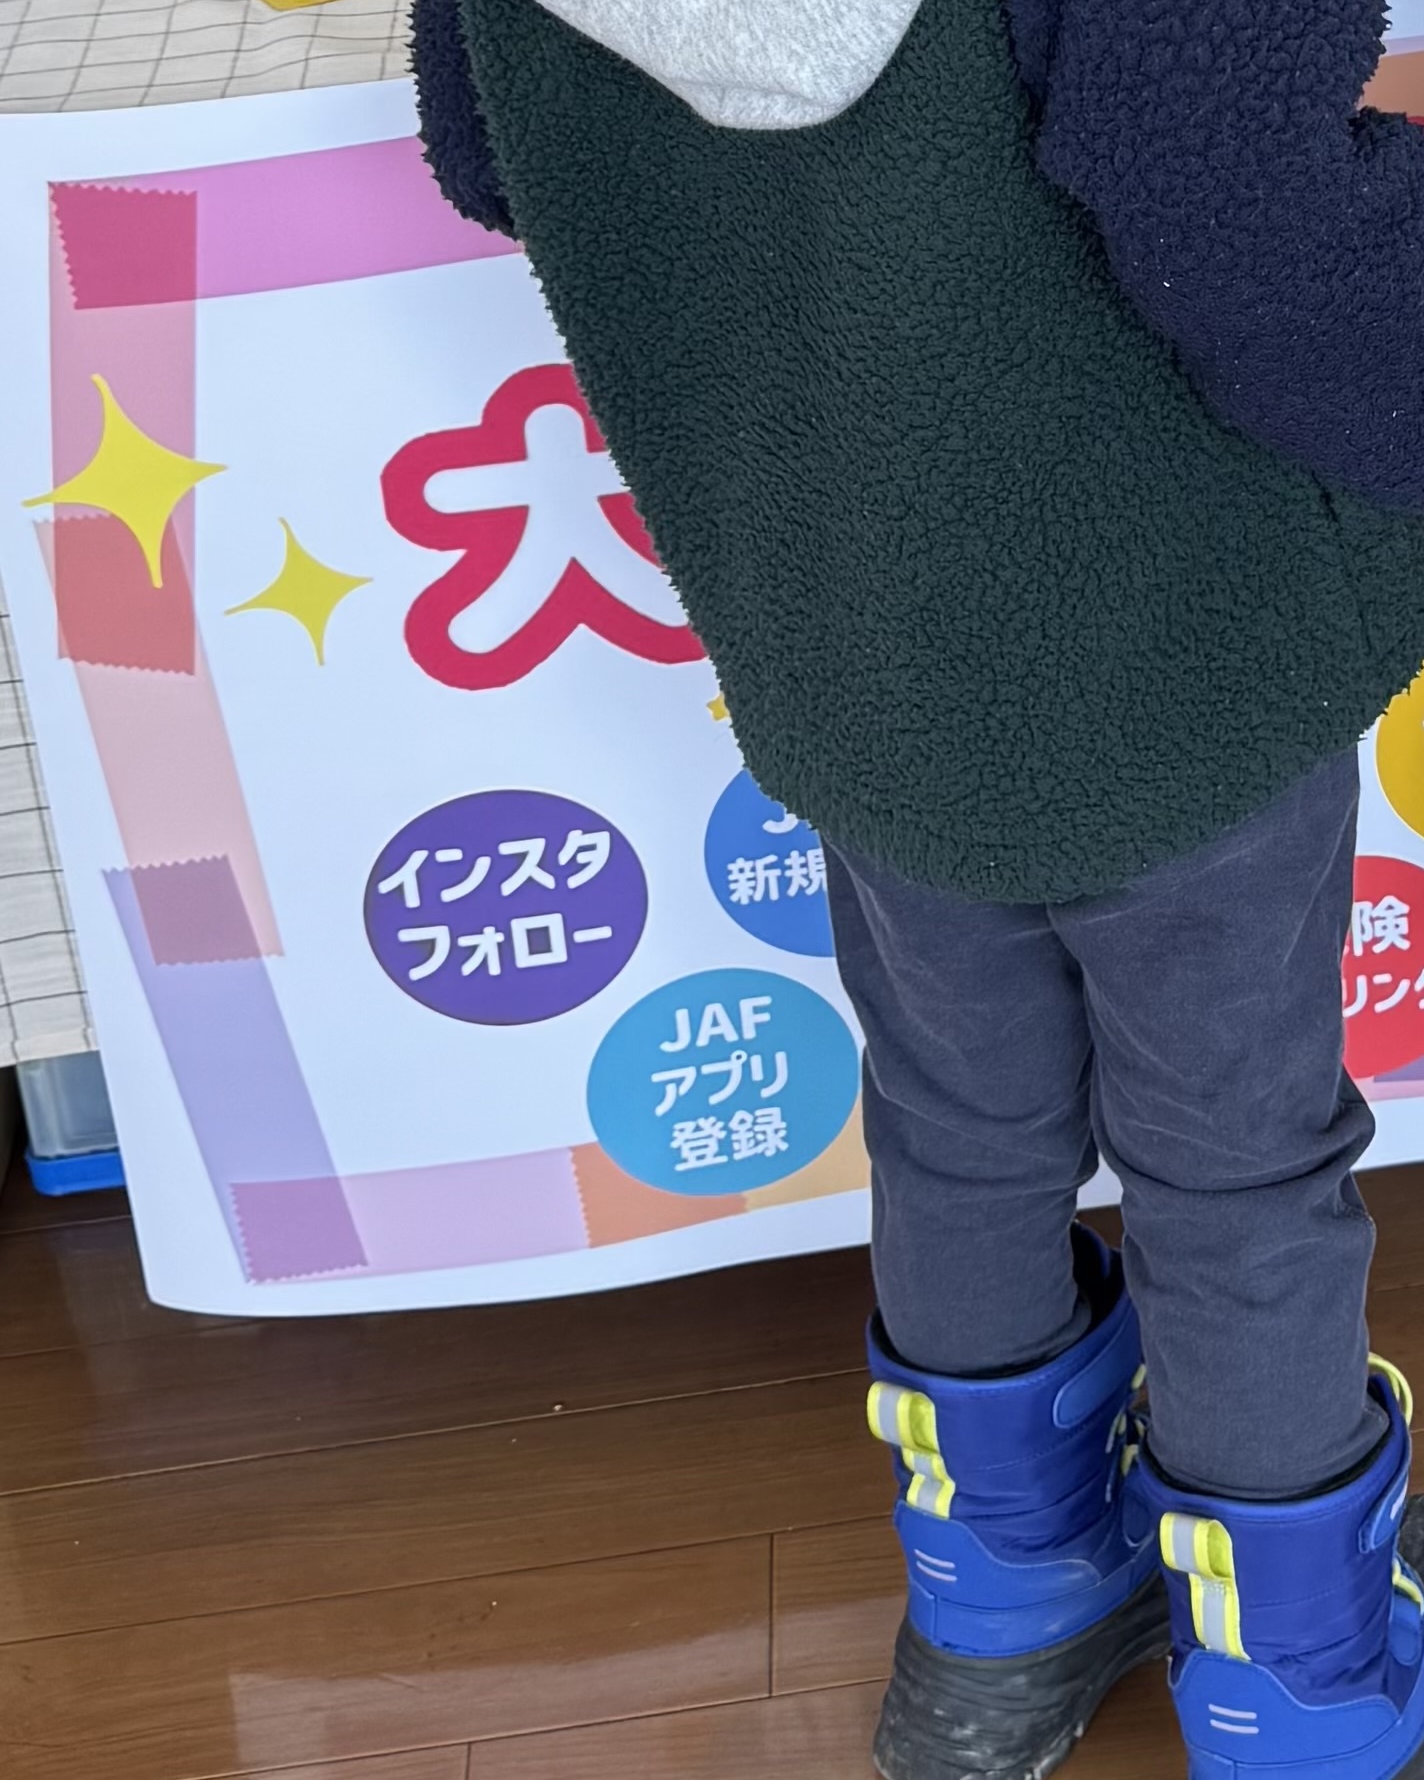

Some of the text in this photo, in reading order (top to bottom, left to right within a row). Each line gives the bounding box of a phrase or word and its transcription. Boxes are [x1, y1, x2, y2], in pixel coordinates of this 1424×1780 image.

[376, 829, 613, 910] インスタ
[727, 848, 828, 906] 新規
[397, 911, 614, 982] フォロー
[1344, 894, 1412, 957] 険
[658, 996, 774, 1053] JAF
[651, 1050, 790, 1117] アプリ
[669, 1106, 791, 1174] 登録
